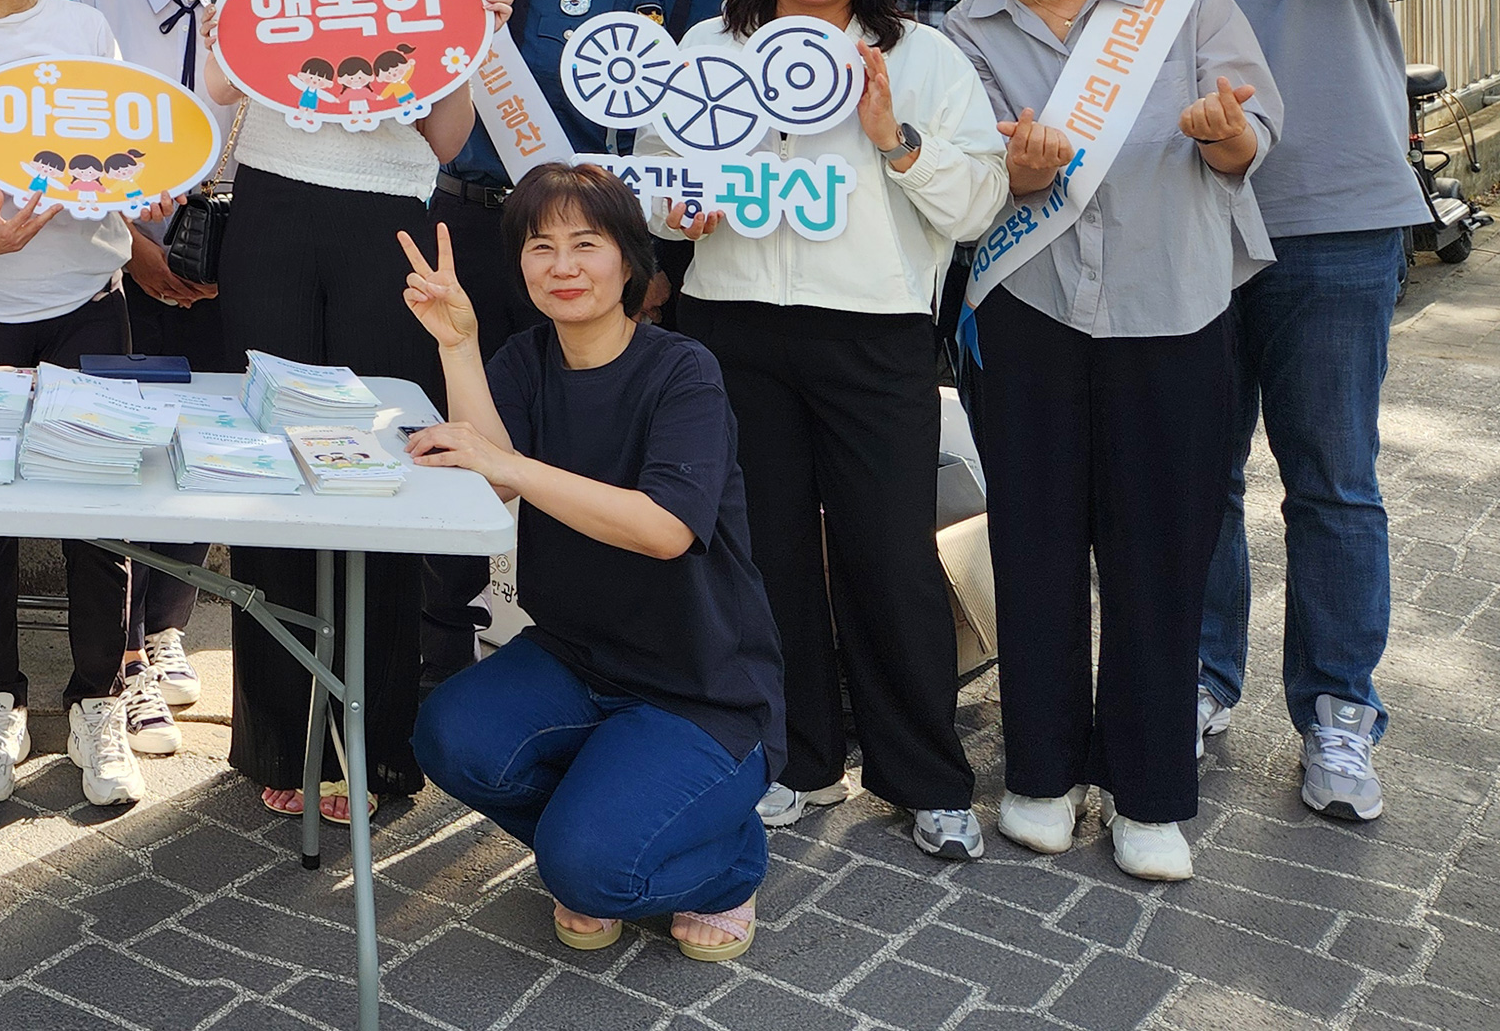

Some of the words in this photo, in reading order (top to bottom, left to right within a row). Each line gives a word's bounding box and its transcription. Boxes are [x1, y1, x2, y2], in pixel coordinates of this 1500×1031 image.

[495, 93, 547, 158] 광산
[1065, 74, 1121, 142] 되는
[599, 165, 704, 220] 가능
[715, 162, 847, 233] 광산
